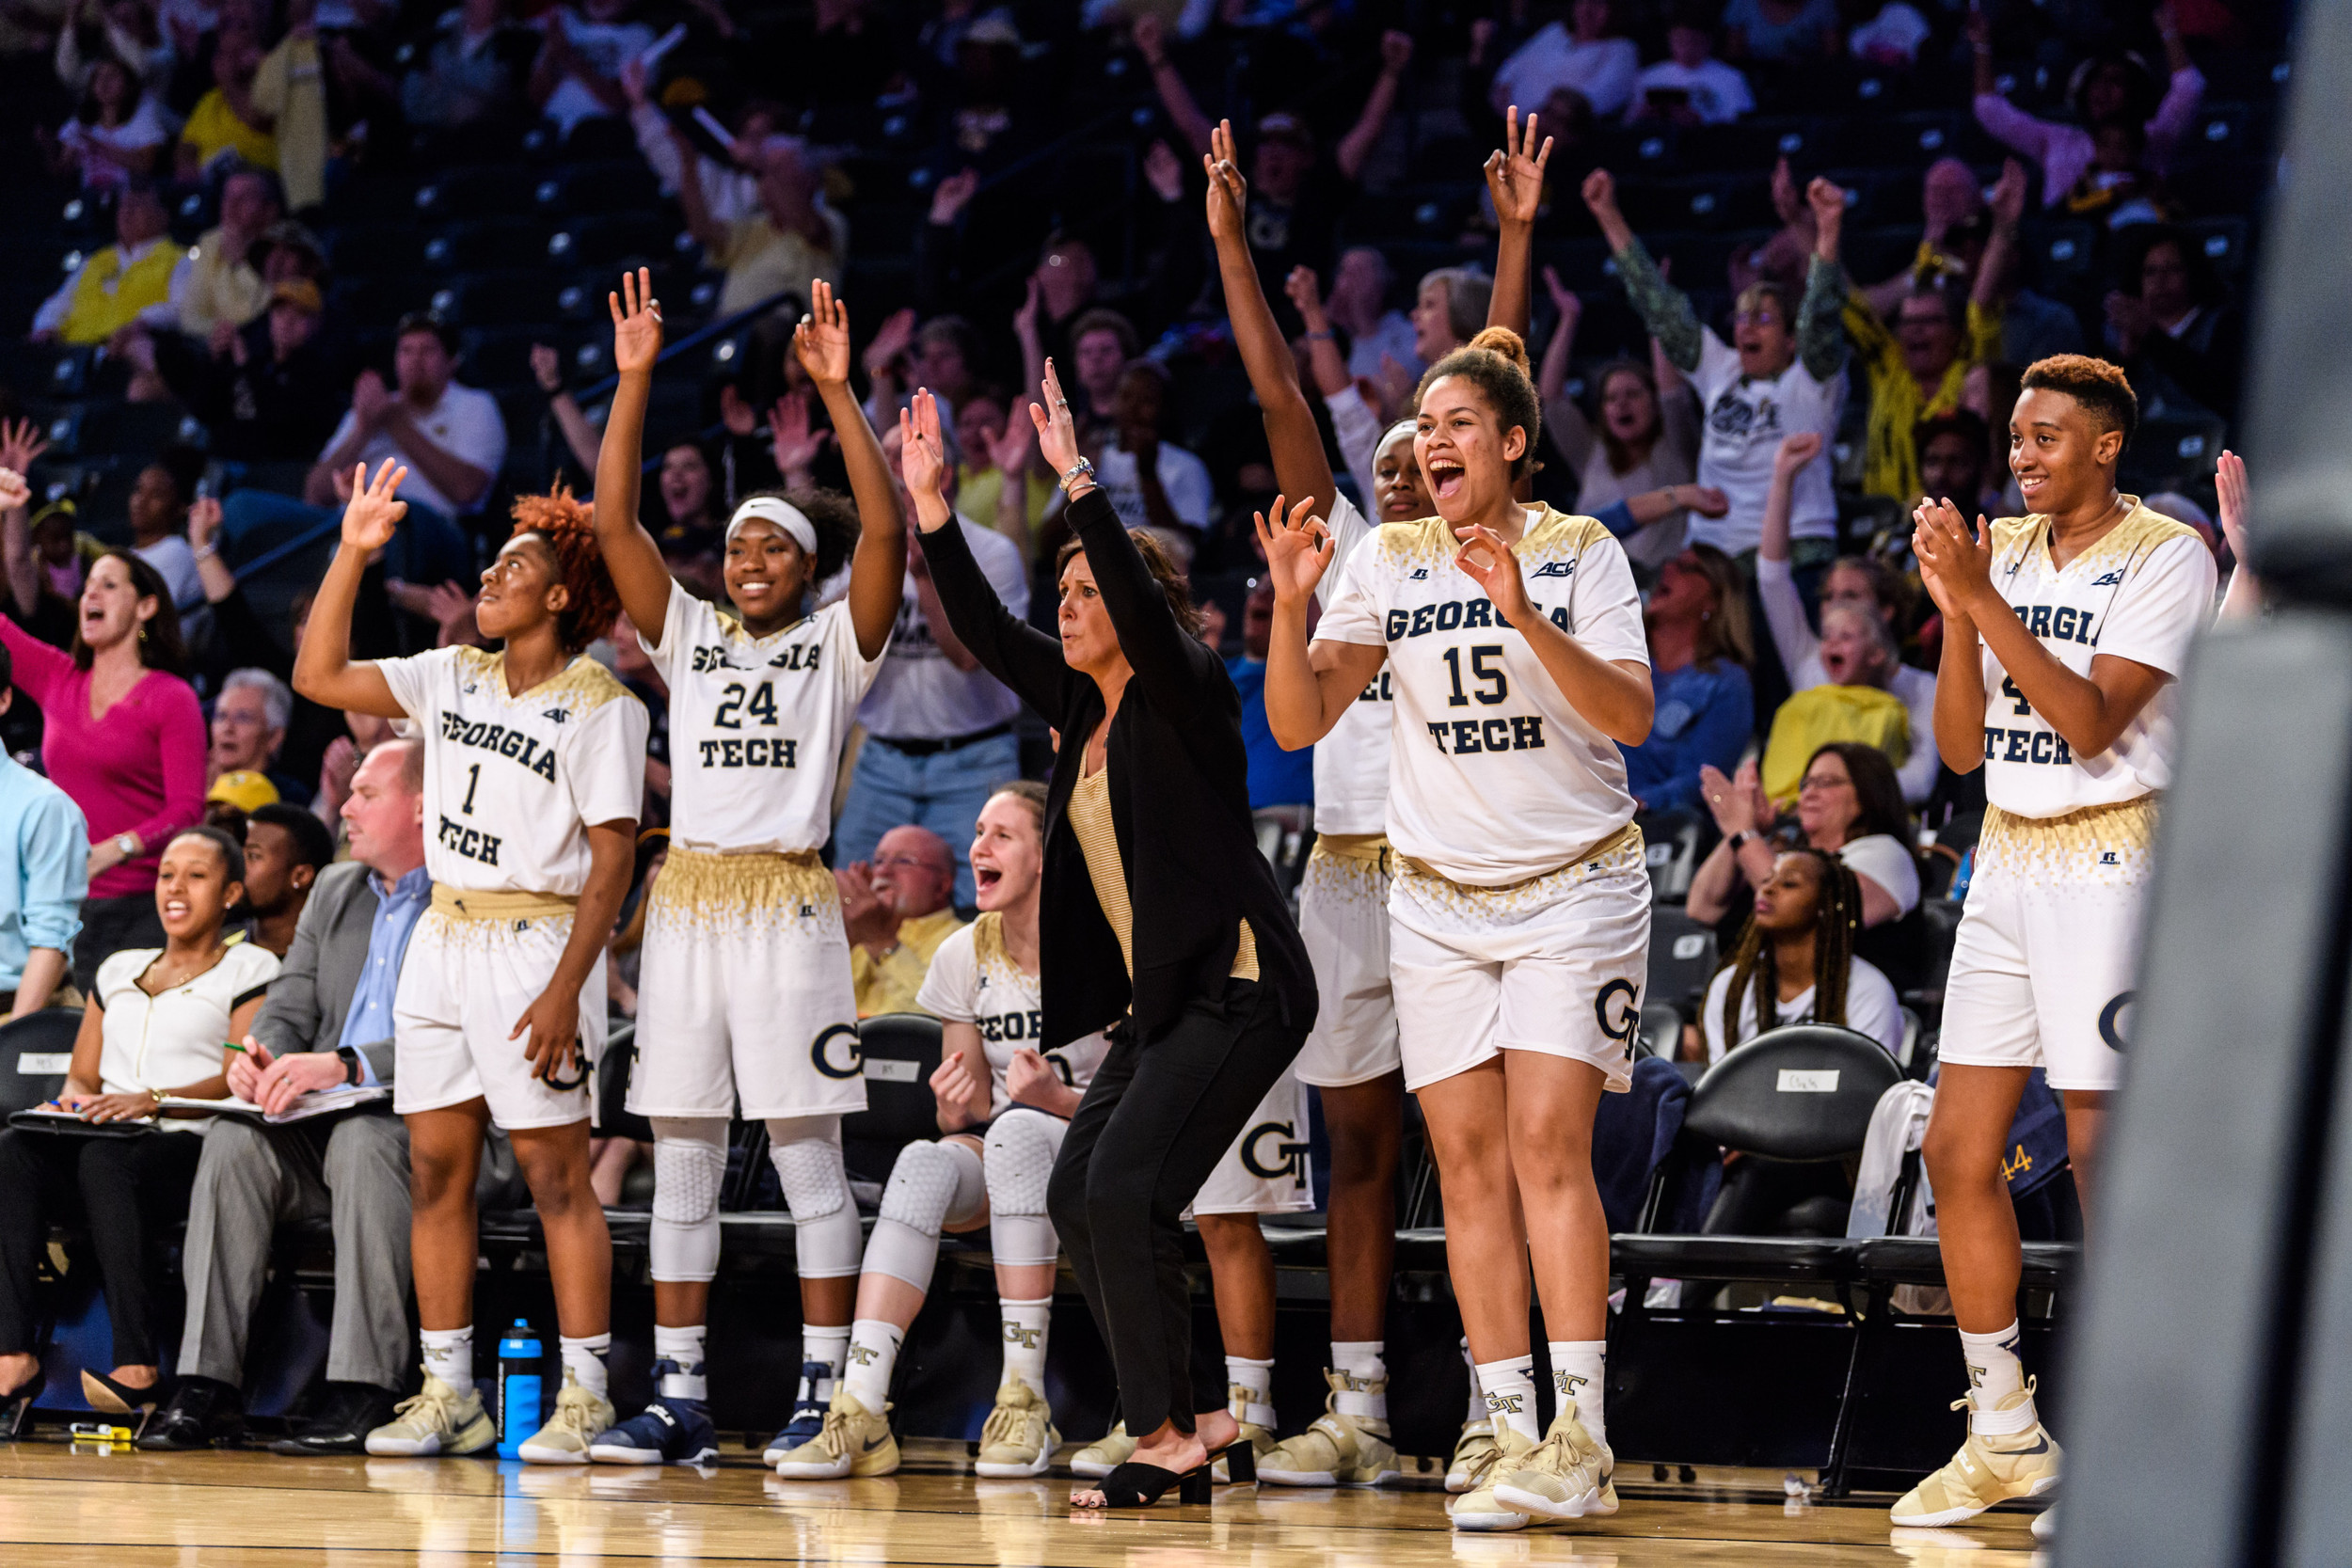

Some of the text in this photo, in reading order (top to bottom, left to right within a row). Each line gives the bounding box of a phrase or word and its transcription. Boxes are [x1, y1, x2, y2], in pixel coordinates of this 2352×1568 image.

[1441, 643, 1510, 708] 15
[714, 680, 778, 729] 24
[699, 738, 798, 769] TECH
[1426, 715, 1546, 755] TECH
[1984, 725, 2073, 766] TECH
[462, 763, 481, 816] 1
[1239, 1120, 1311, 1191] GT
[1002, 1320, 1041, 1349] GT
